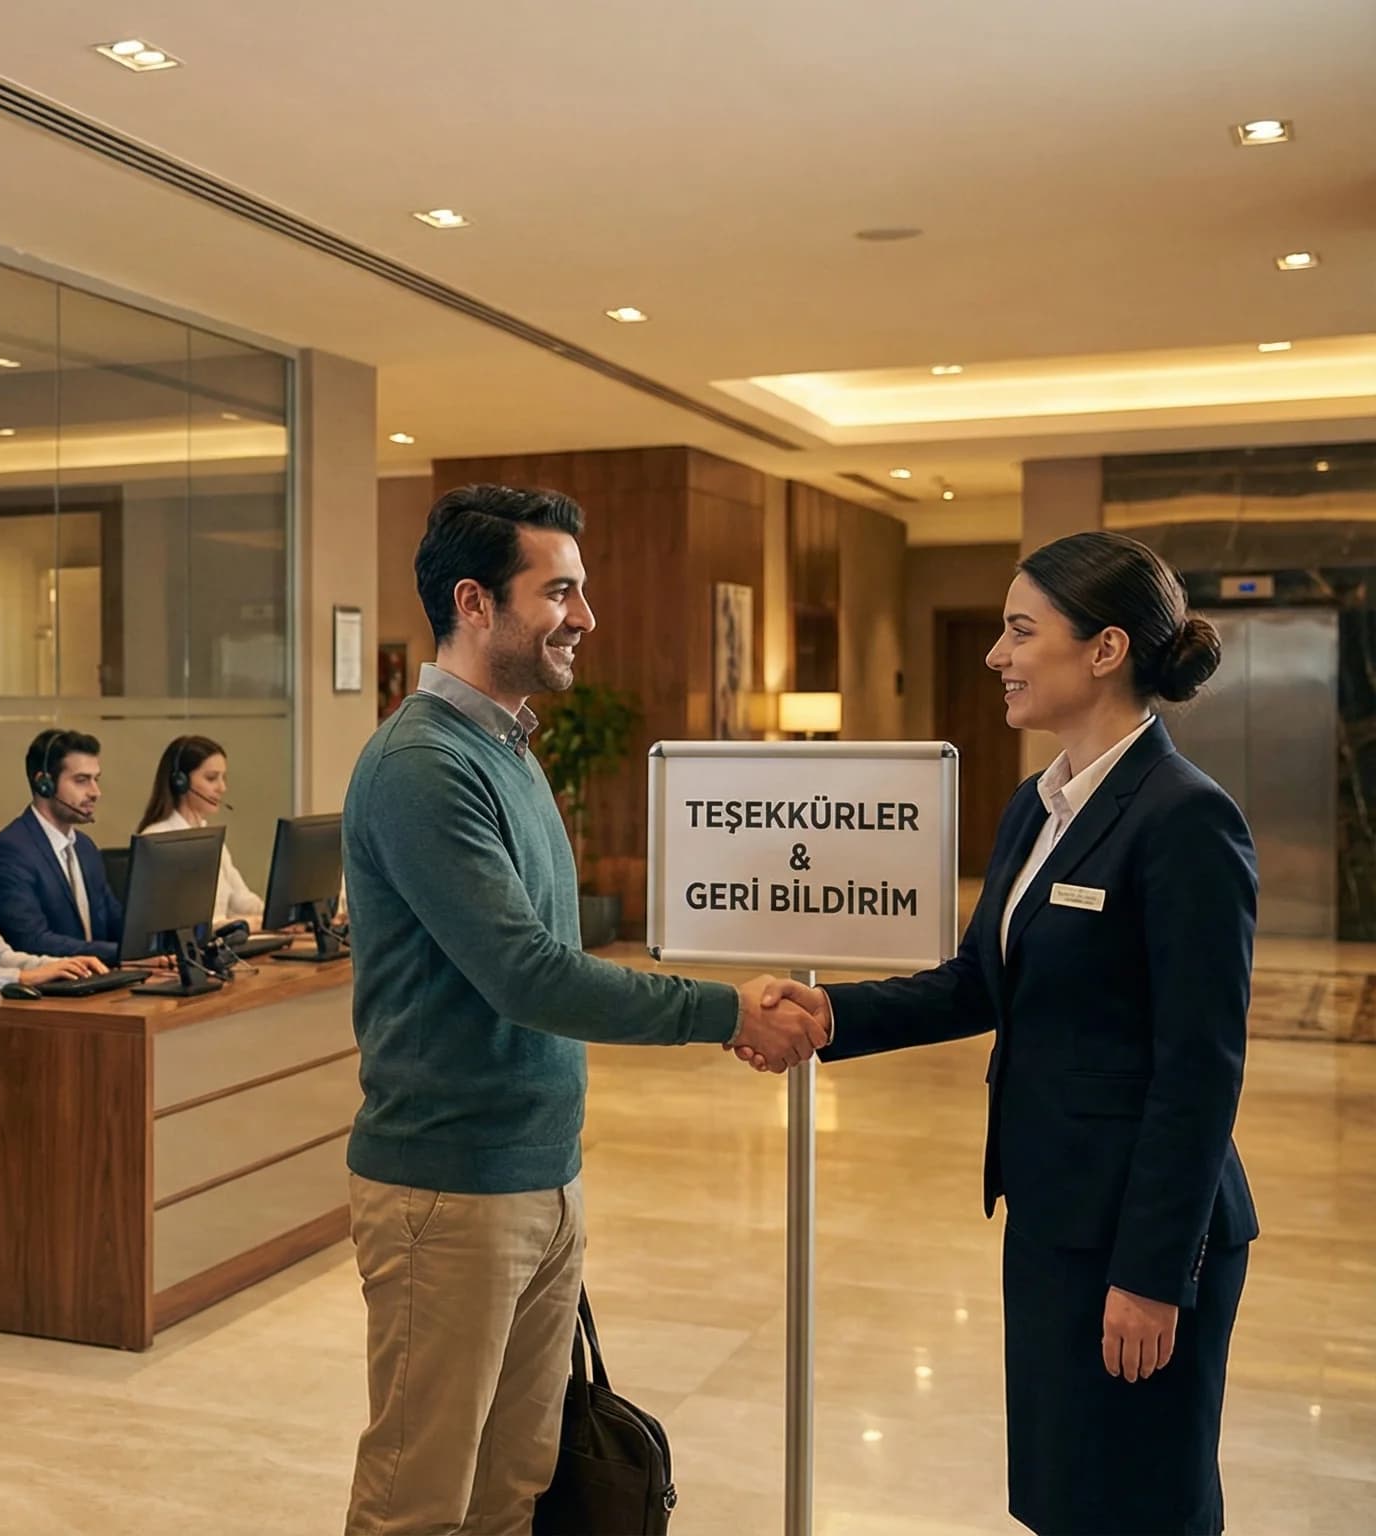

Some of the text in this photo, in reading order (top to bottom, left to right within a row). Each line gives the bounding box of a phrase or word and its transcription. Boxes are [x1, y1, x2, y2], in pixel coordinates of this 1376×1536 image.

[685, 795, 920, 834] TEŞEKKÜRLER
[789, 843, 811, 871] &
[685, 877, 918, 916] GERİ BİLDİRİM
